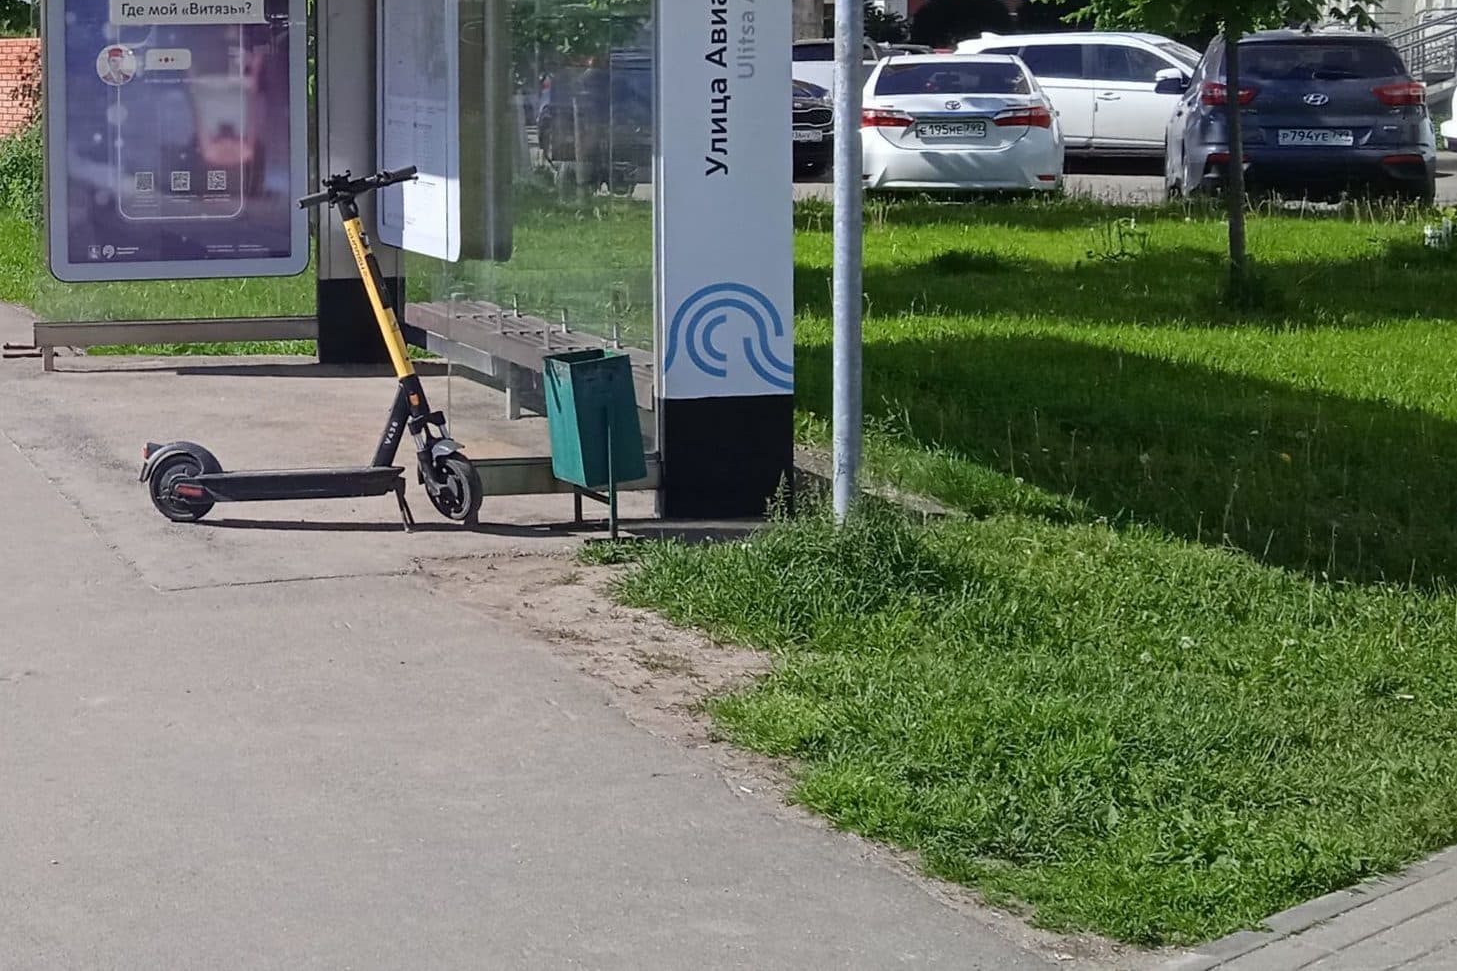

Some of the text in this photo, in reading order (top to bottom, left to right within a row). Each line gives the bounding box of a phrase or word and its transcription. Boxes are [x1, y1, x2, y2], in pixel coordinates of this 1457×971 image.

[121, 1, 252, 17] Где мой «Витязь»?
[737, 11, 756, 79] Ulitsa
[705, 78, 732, 176] Улица
